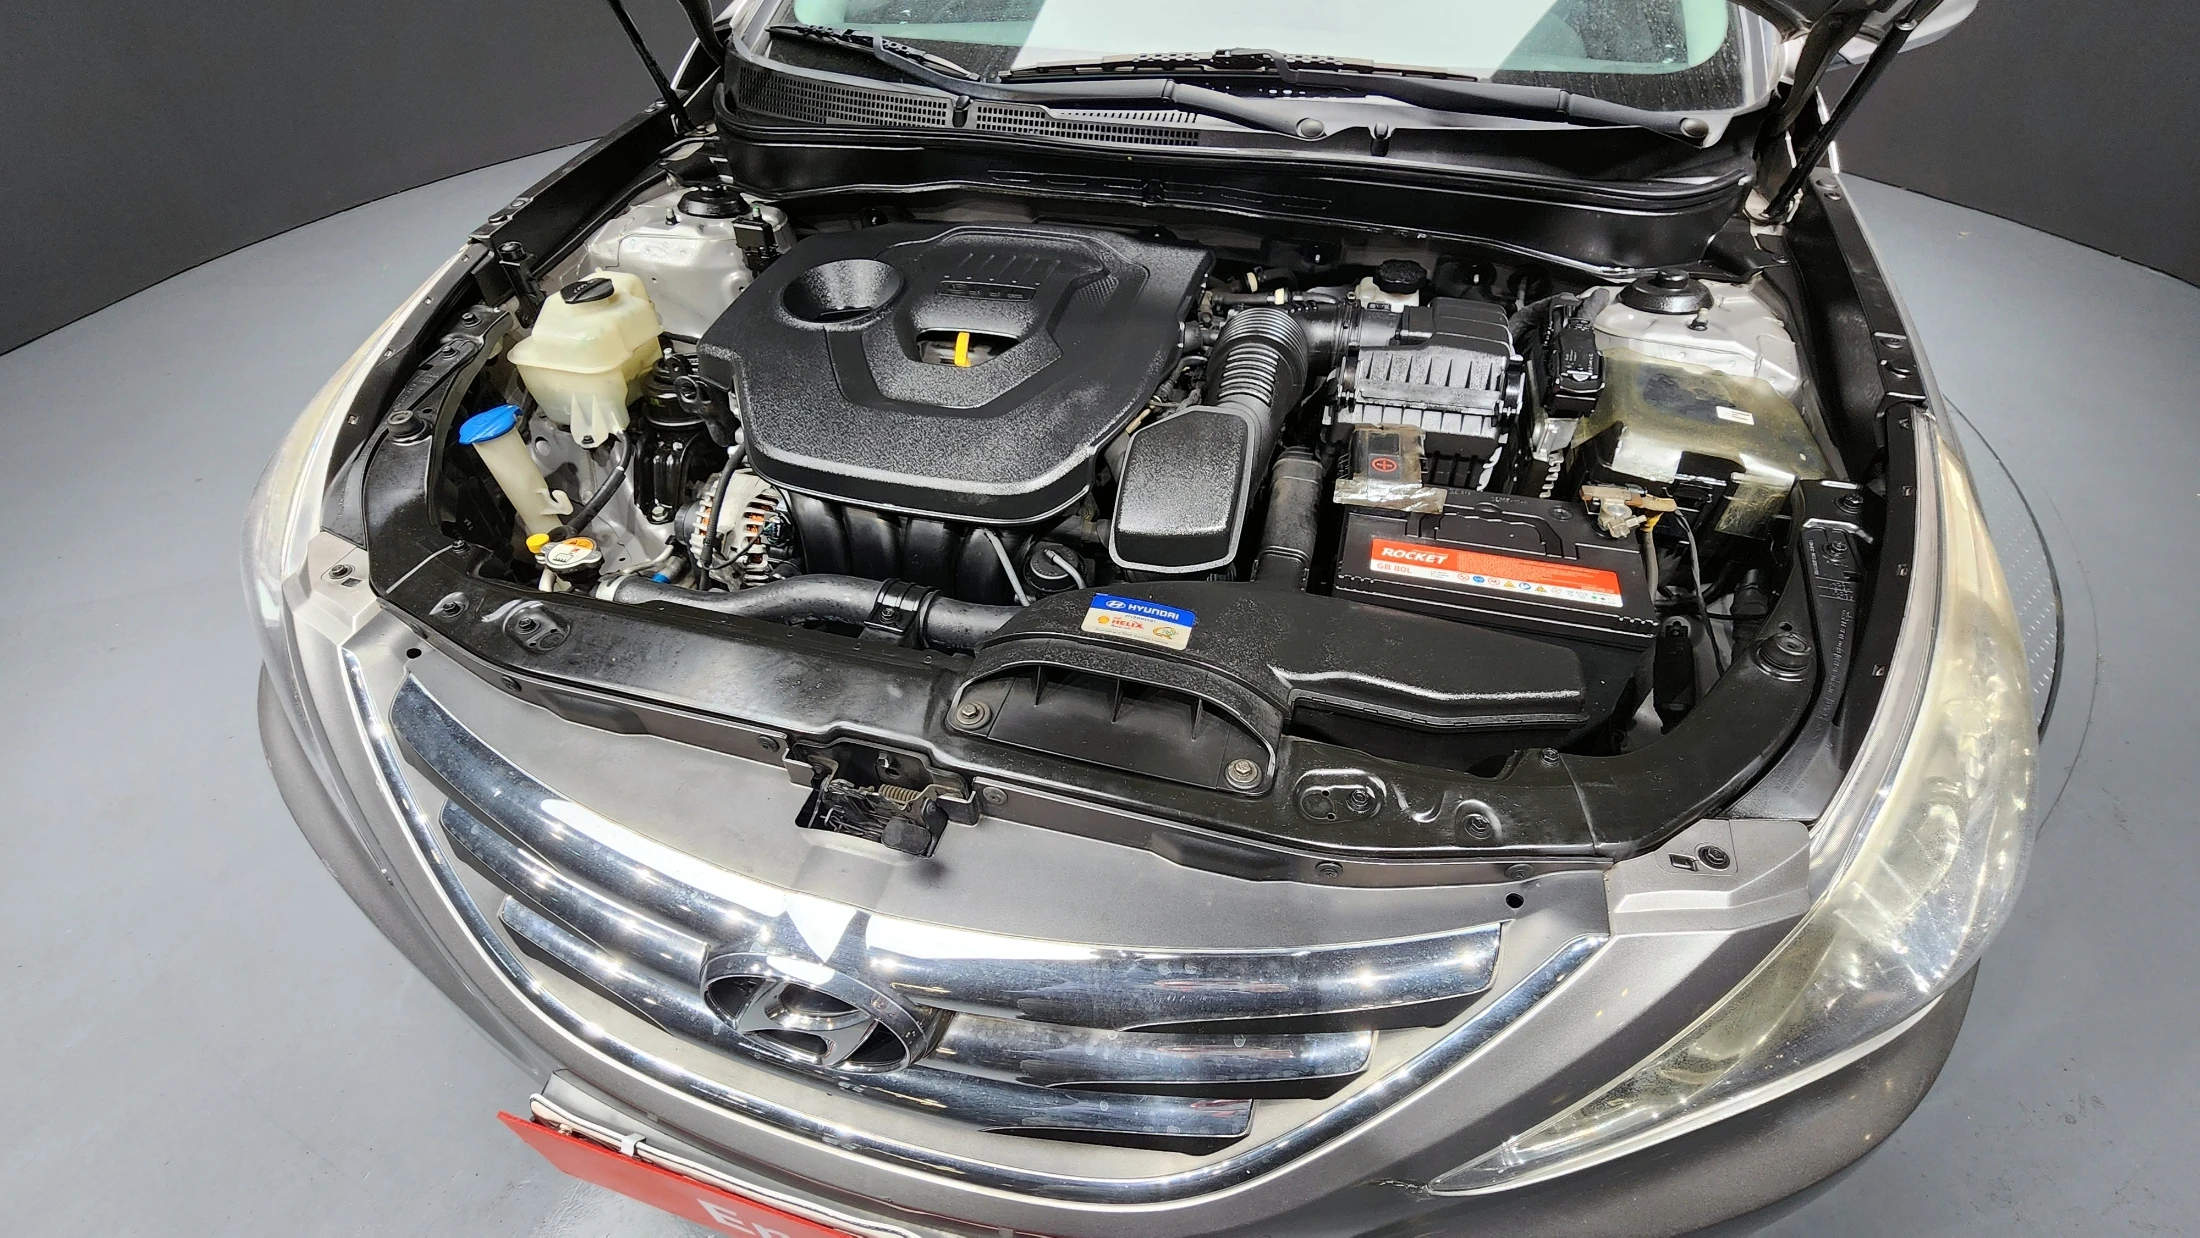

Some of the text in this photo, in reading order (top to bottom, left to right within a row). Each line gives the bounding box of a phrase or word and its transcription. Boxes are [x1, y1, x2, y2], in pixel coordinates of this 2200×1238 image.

[1381, 547, 1449, 564] ROCKET
[1377, 562, 1413, 574] GB 80L
[1128, 603, 1180, 620] HYUNDAI
[1111, 618, 1143, 630] HELIX
